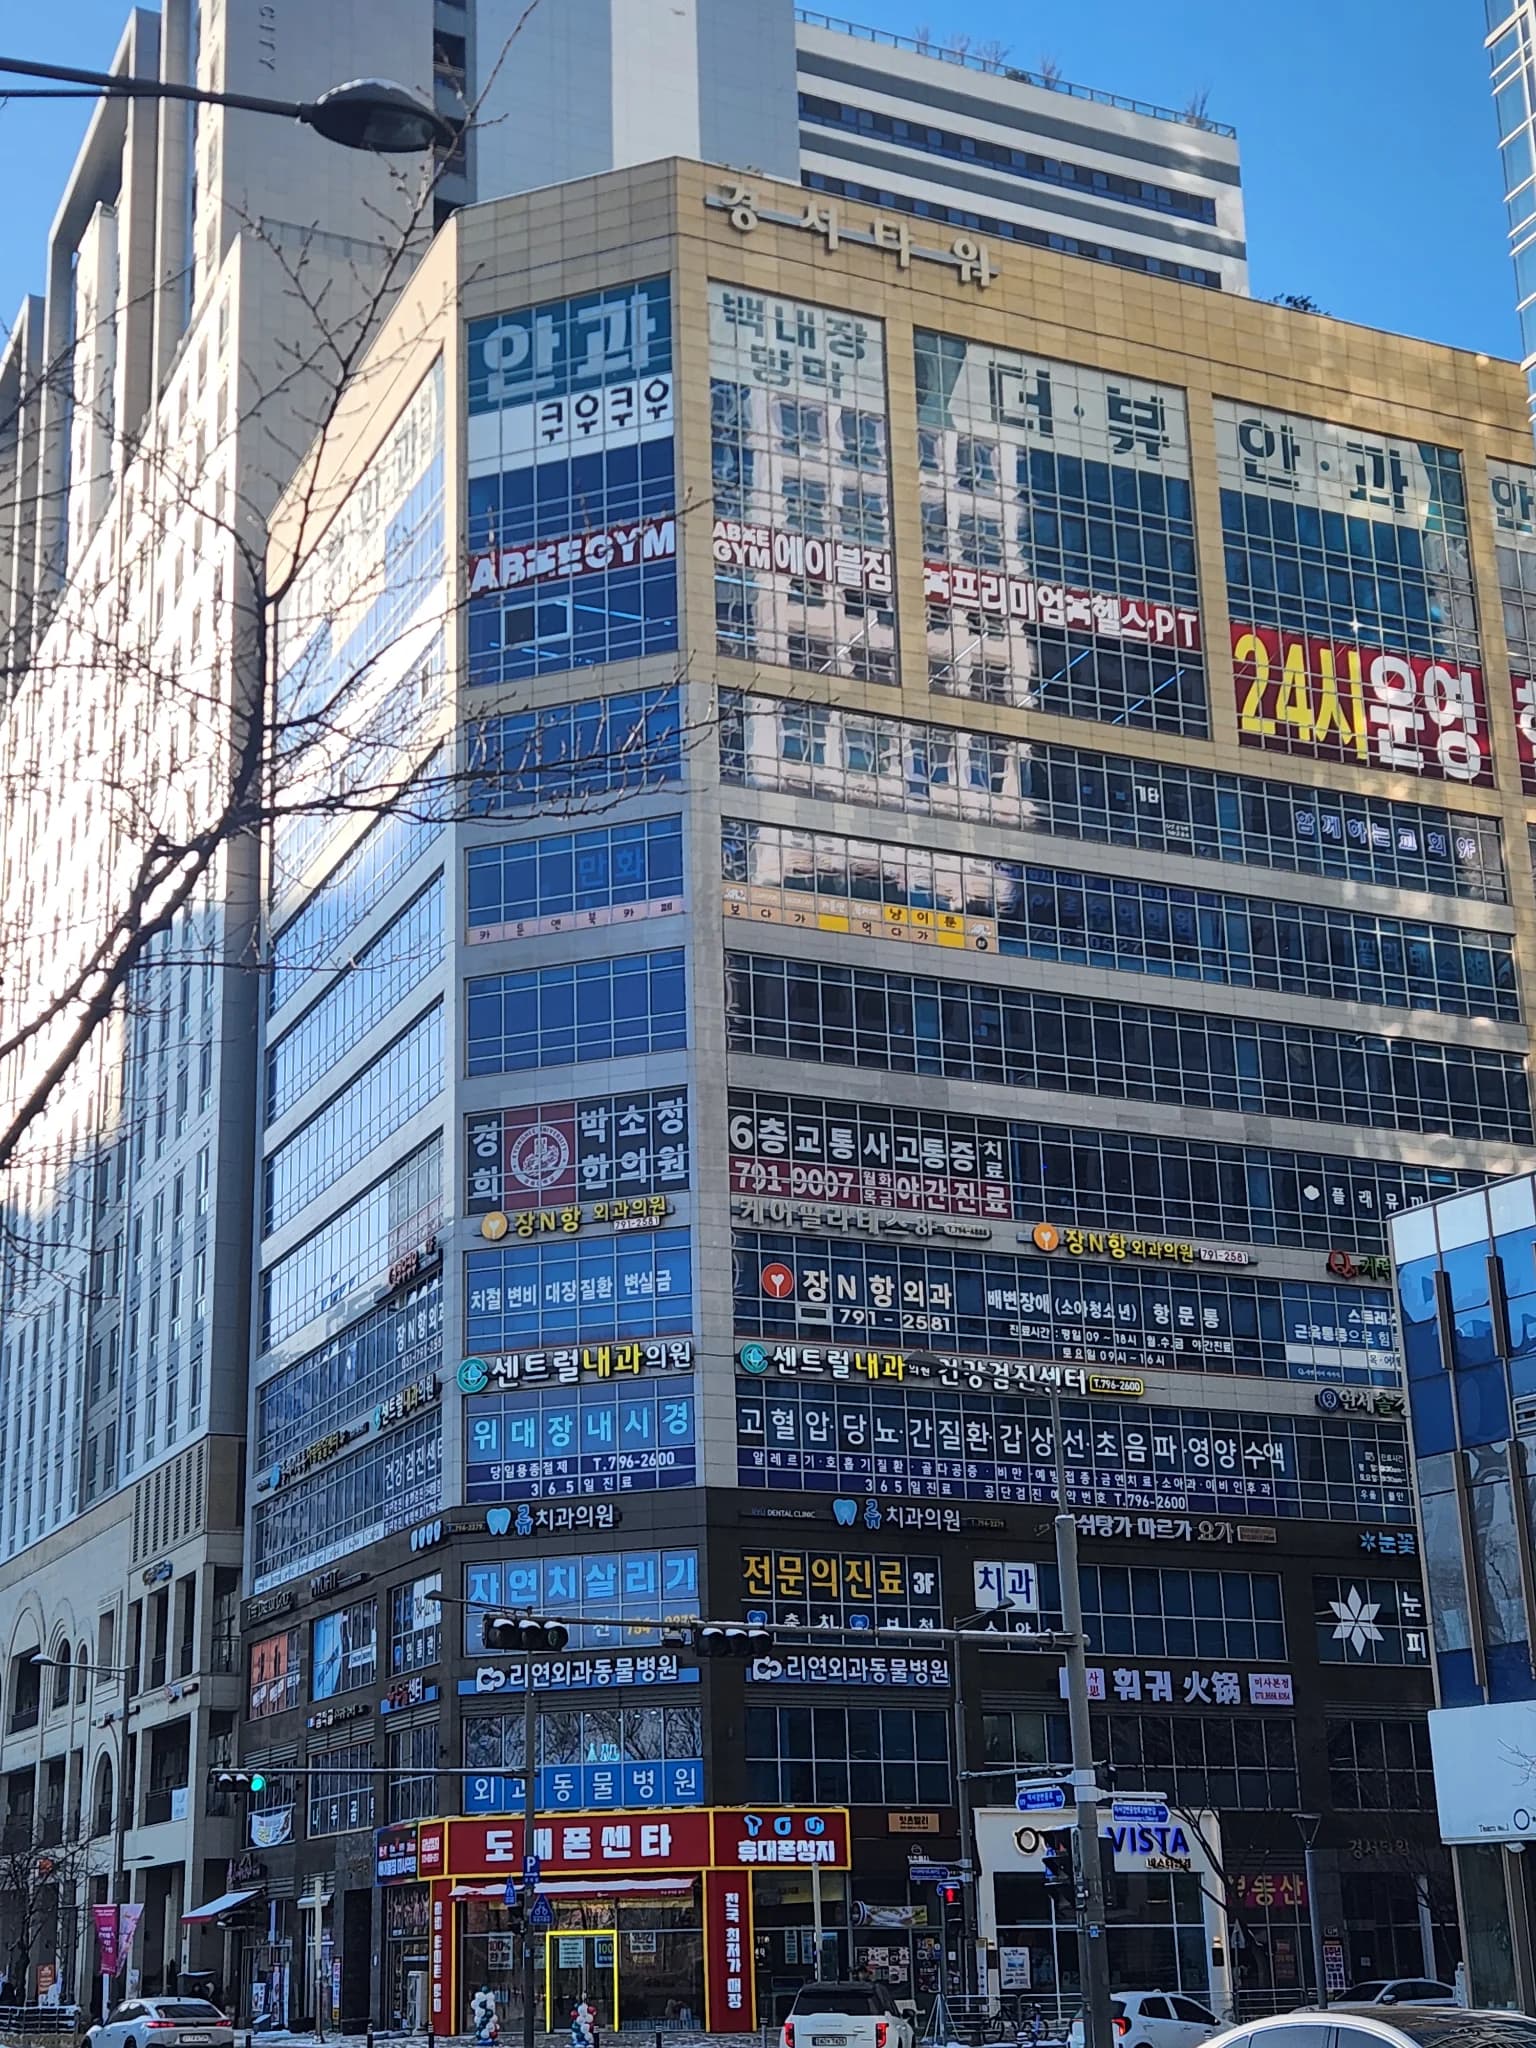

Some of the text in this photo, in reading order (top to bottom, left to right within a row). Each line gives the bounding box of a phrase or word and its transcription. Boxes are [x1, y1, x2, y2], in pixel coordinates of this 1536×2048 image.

[718, 181, 990, 287] 경서타워
[722, 292, 868, 360] 백내장
[482, 291, 656, 401] 안과
[541, 377, 669, 443] 쿠우쿠우
[713, 540, 770, 570] GYM
[775, 533, 891, 593] 에이블짐
[1234, 633, 1367, 761] 24시
[1369, 655, 1481, 780] 운영
[1295, 811, 1477, 860] 함께하는교회 9F
[579, 848, 644, 888] 만화
[731, 903, 806, 924] 보다가
[862, 921, 929, 940] 먹다가
[581, 1097, 684, 1143] 박소정
[473, 1121, 498, 1201] 경희
[582, 1143, 686, 1191] 한의원
[862, 1170, 892, 1187] 월화
[733, 1160, 855, 1200] 791-9007
[862, 1189, 893, 1207] 목금
[896, 1175, 1009, 1214] 야간진료
[514, 1195, 667, 1238] 장N항 외과의원
[1065, 1229, 1194, 1264] 장N항 외과의원
[1201, 1249, 1247, 1264] 791-2581
[507, 1284, 537, 1308] 변비
[545, 1276, 613, 1304] 대장질환
[624, 1269, 672, 1295] 변실금
[903, 1280, 953, 1310] 외과
[986, 1289, 1220, 1329] 배변장애 (소아청소년) 항문통
[1009, 1323, 1050, 1340] 진료시간
[1061, 1328, 1082, 1341] 평일
[1086, 1331, 1100, 1343] 09
[1191, 1339, 1233, 1353] 야간진료
[1062, 1347, 1096, 1361] 토요일
[1093, 1378, 1140, 1392] T.796-2600
[473, 1400, 688, 1450] 위대장내시경
[490, 1451, 675, 1480] 당일용종절제 T.796-2600
[1198, 1520, 1233, 1544] 요가
[470, 1556, 696, 1604] 자연치살리기
[743, 1555, 935, 1599] 전문의진료 3F
[978, 1566, 1034, 1604] 치과
[509, 1654, 678, 1687] 리연외과동물병원
[787, 1655, 949, 1685] 리연외과동물병원
[1112, 1667, 1173, 1702] 훠궈
[1183, 1670, 1241, 1705] 火锅
[737, 1840, 836, 1863] 휴대폰성지
[1106, 1826, 1190, 1854] VISTA
[526, 1856, 537, 1873] P
